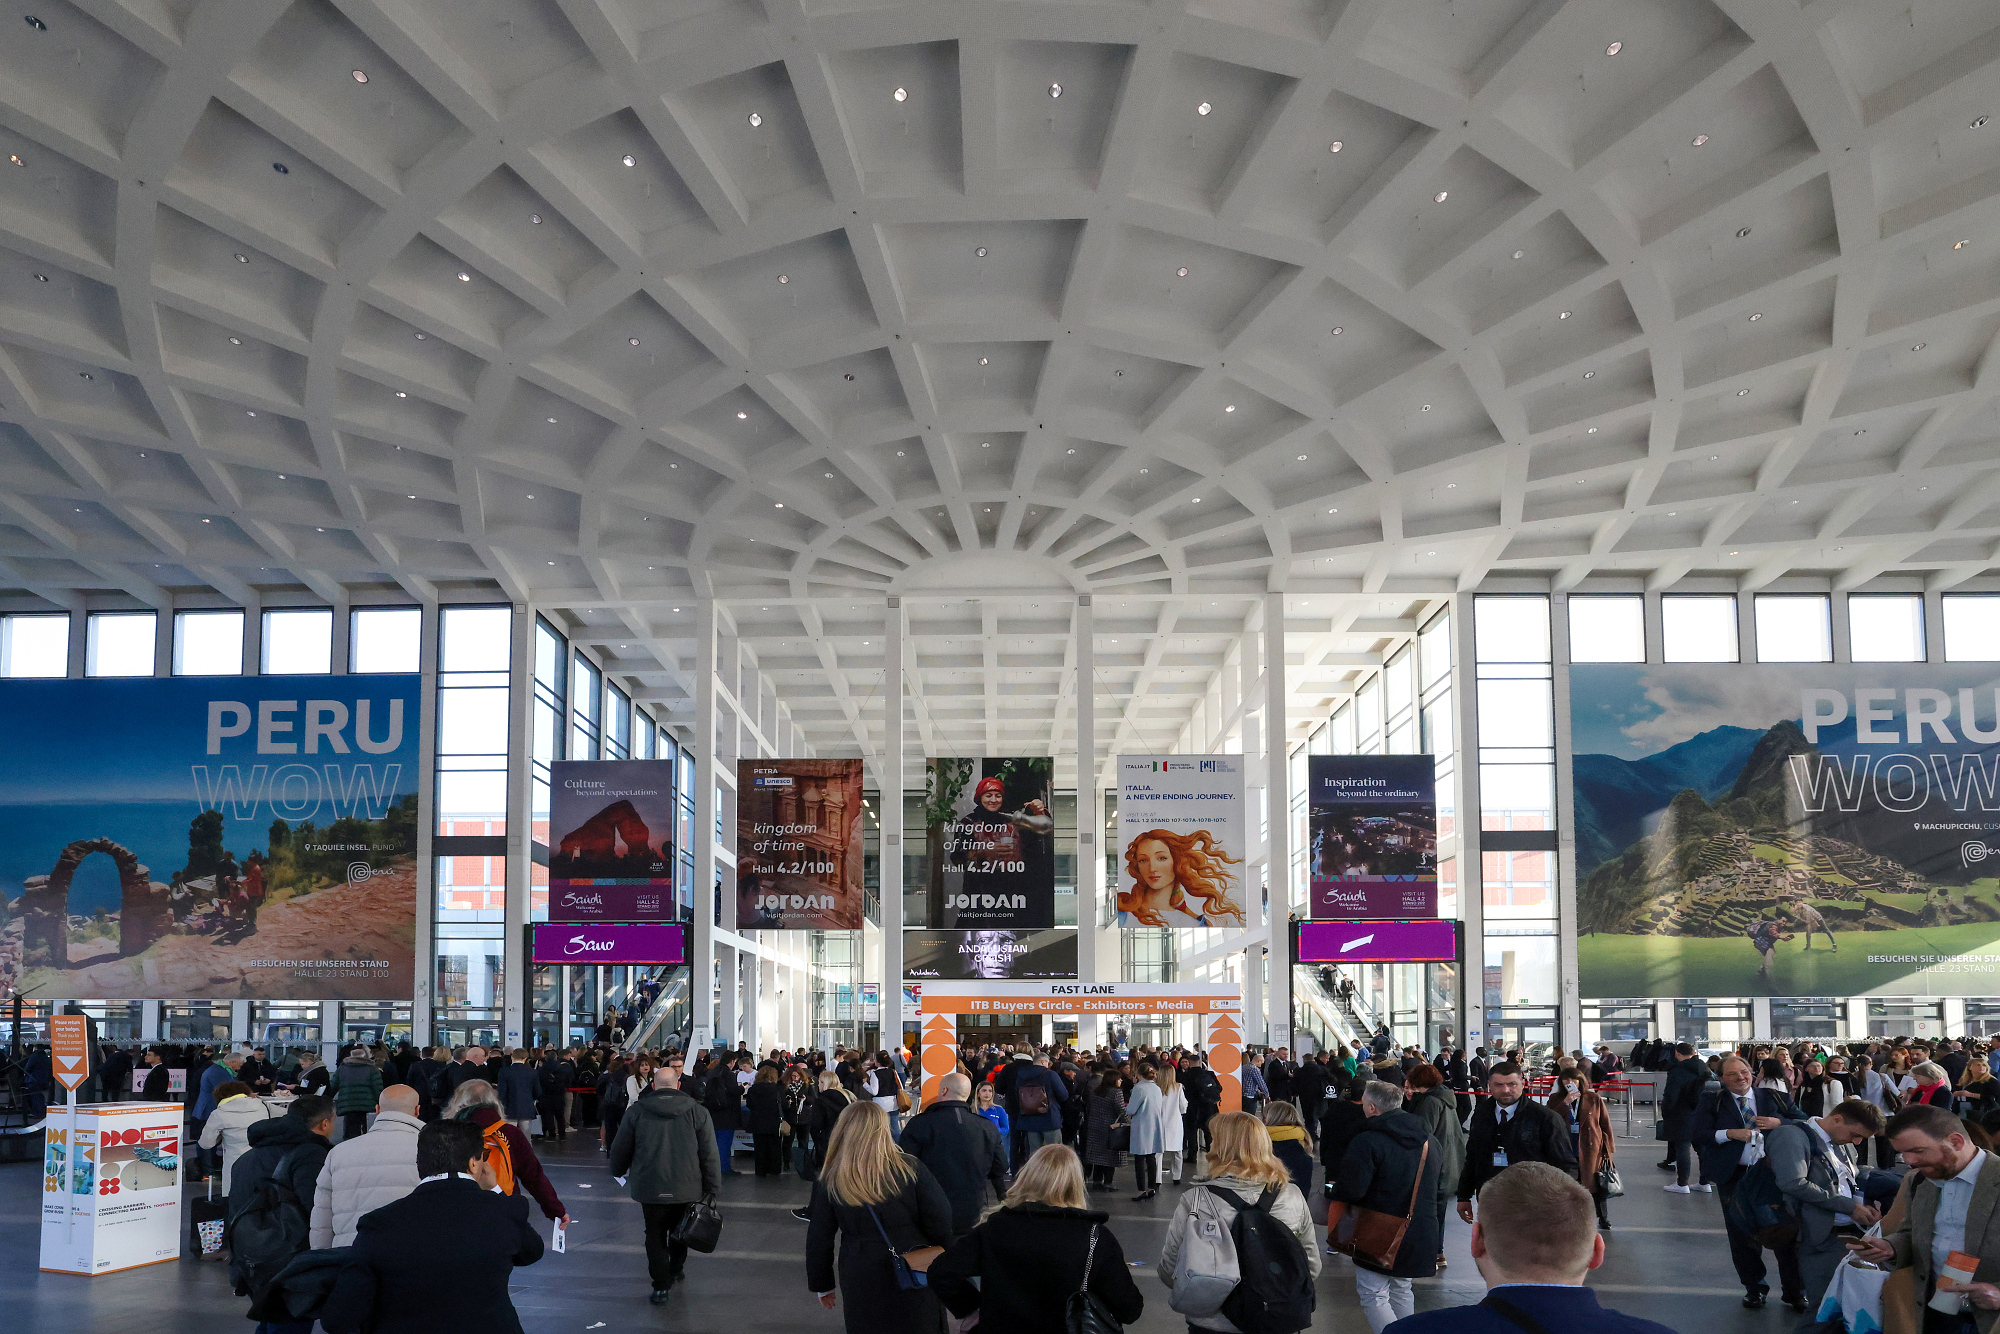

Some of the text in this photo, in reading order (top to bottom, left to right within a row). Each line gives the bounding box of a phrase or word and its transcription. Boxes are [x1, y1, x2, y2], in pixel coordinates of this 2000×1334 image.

[1801, 688, 2000, 744] PERU
[206, 699, 403, 755] PERU
[564, 779, 606, 789] Culture
[1324, 777, 1387, 790] Inspiration
[1789, 754, 2000, 812] WOW
[191, 763, 402, 821] WOW
[575, 788, 658, 798] beyond expectations
[1336, 789, 1420, 799] beyond the ordinary
[753, 822, 817, 836] kingdom
[942, 821, 1008, 835] kingdom
[1984, 822, 2000, 830] CUS
[312, 844, 345, 852] TAQUILE
[753, 839, 805, 854] of time
[943, 838, 996, 853] of time
[752, 860, 835, 875] Hall 4.2/100
[942, 860, 1026, 874] Hall 4.2/100
[766, 912, 823, 920] visitjordan.com
[250, 960, 390, 968] BESUCHEN SIE UNSEREN STAND
[1867, 955, 1918, 963] BESUCHEN
[1920, 955, 1935, 963] SIE
[1937, 955, 1982, 963] UNSEREN
[294, 970, 390, 978] HALLE 23 STAND 100
[1915, 964, 1995, 973] HALLE 23 STAND
[1051, 985, 1115, 994] FAST LANE
[970, 1000, 990, 1010] ITB
[993, 1000, 1035, 1012] Buyers
[1038, 1000, 1073, 1010] Circle
[1083, 1000, 1146, 1010] Exhibitors
[1156, 1000, 1194, 1010] Media
